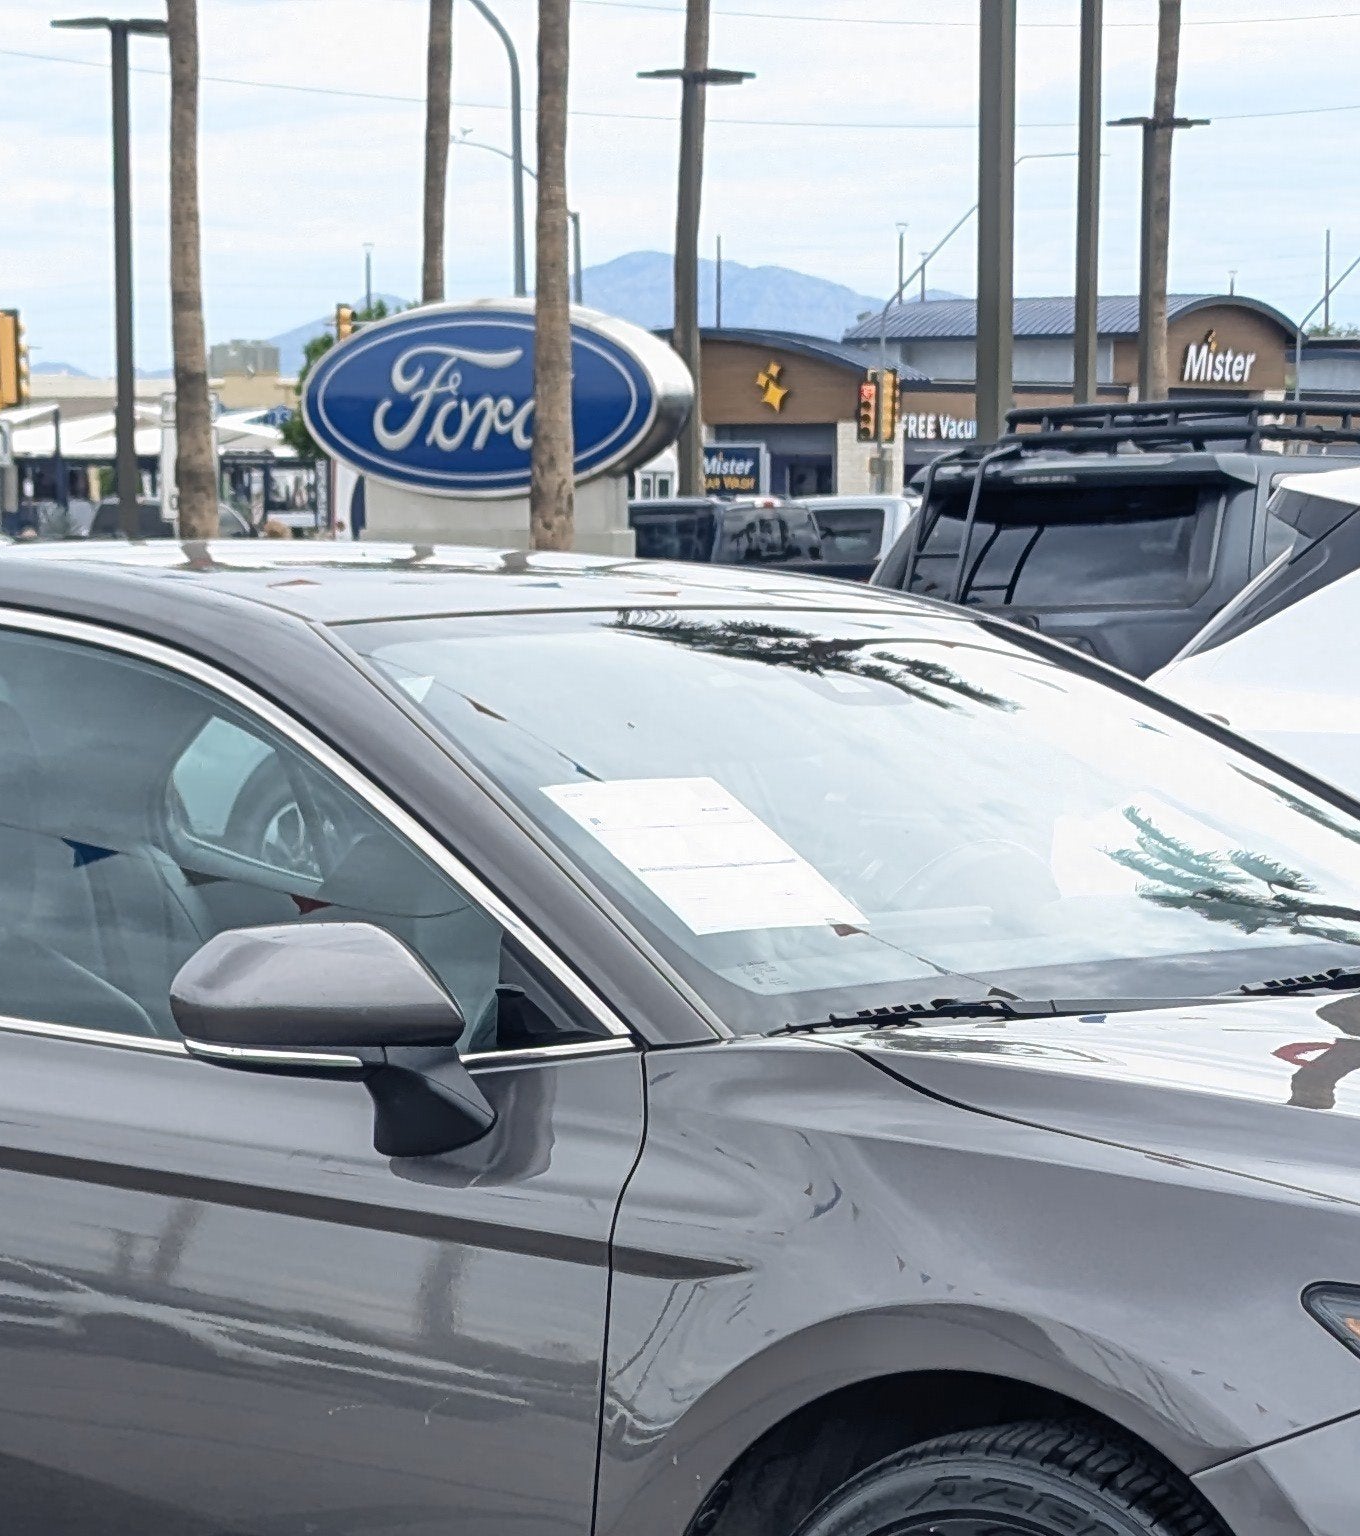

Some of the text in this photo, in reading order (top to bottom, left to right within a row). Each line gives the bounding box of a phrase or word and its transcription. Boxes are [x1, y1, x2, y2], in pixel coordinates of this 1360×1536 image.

[1183, 330, 1256, 382] Mister
[901, 413, 978, 439] FREE Vacu
[703, 455, 755, 475] Mister
